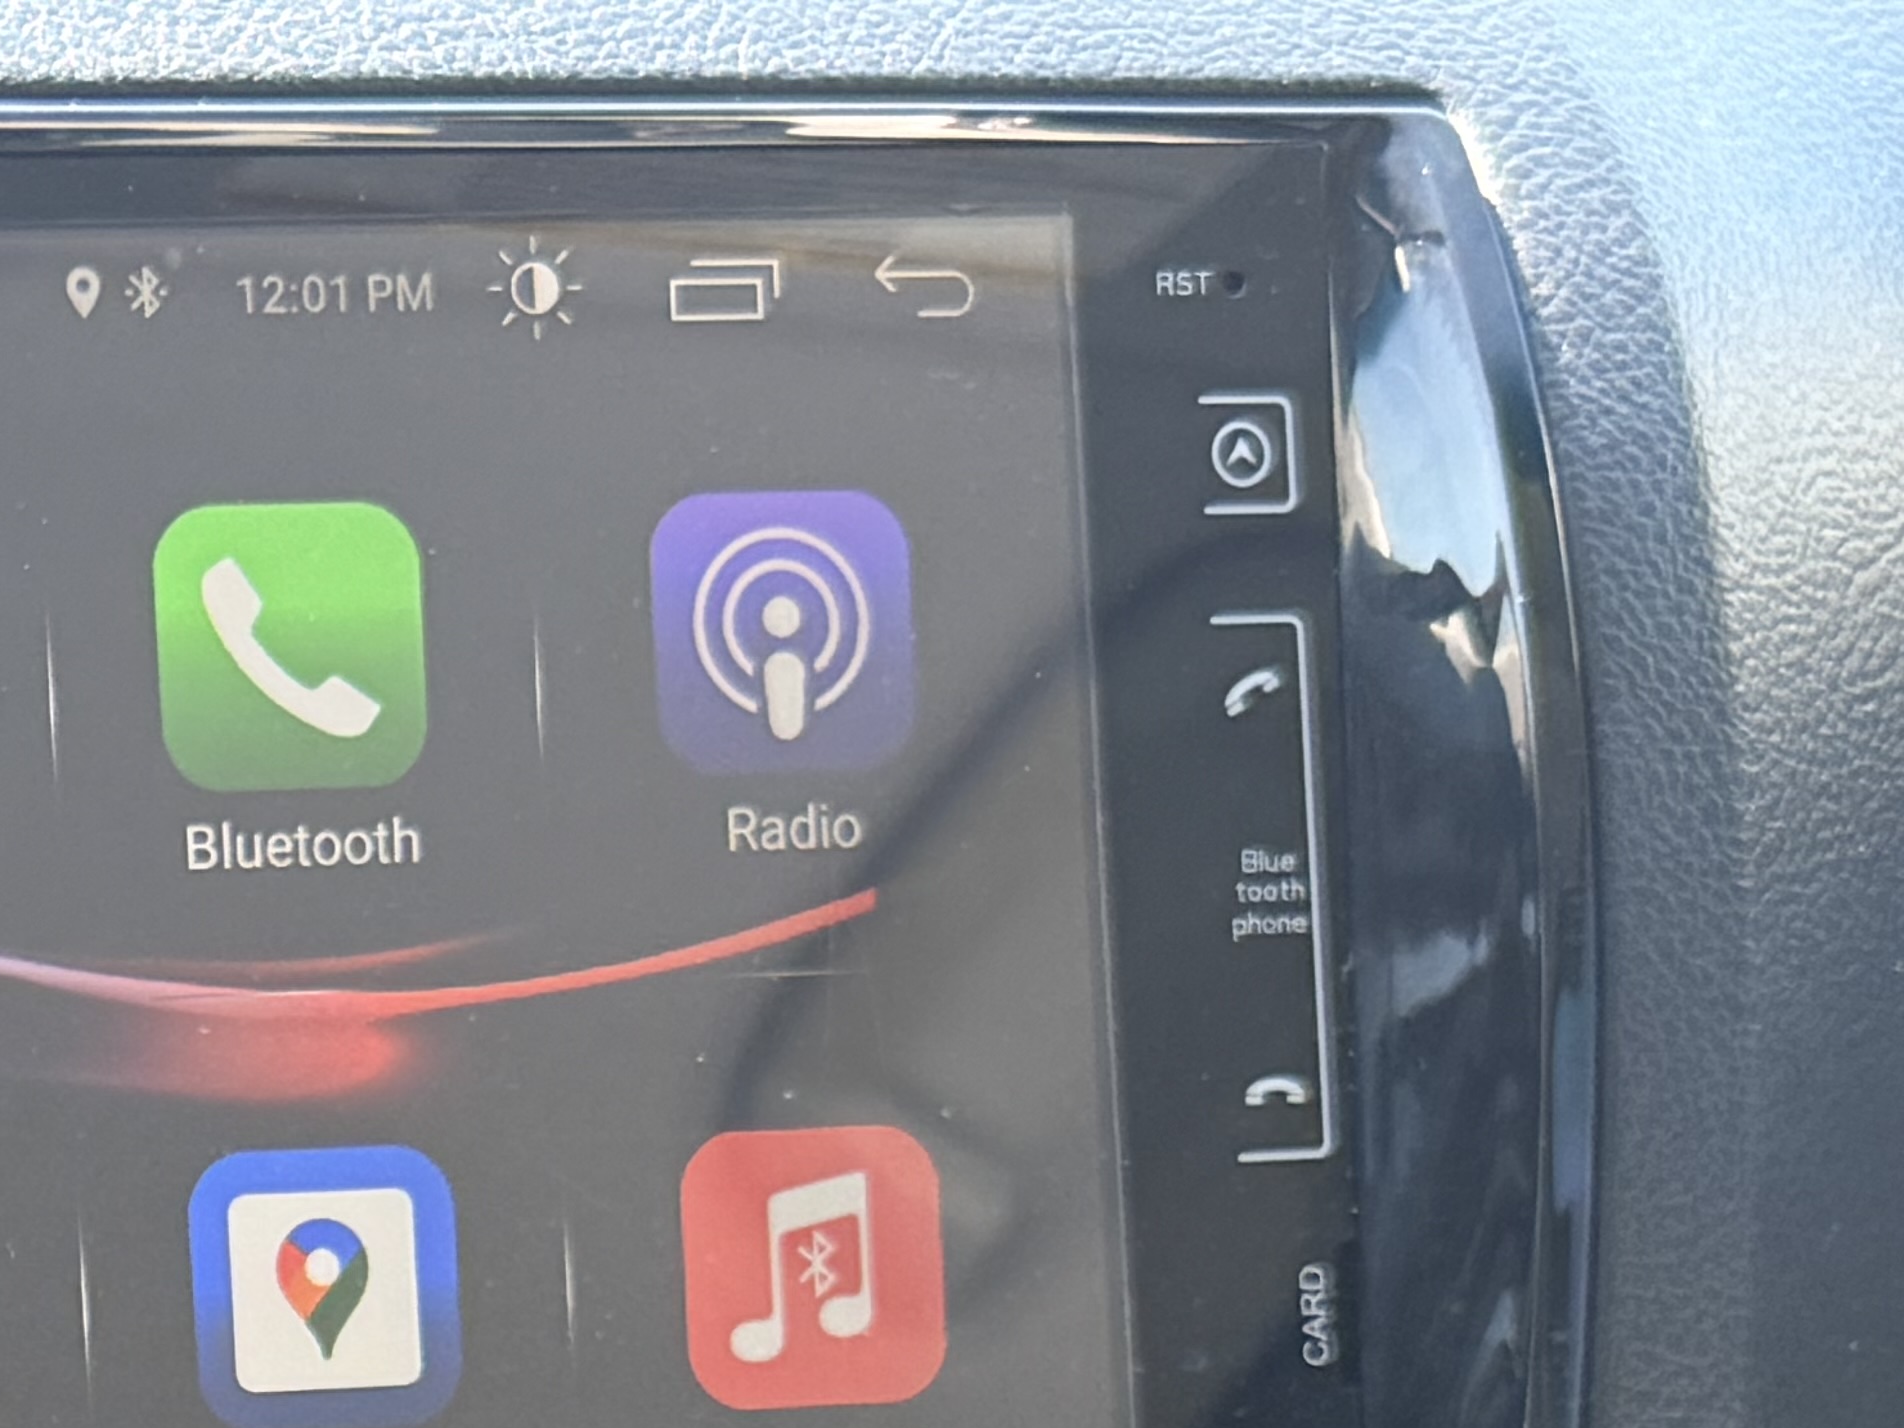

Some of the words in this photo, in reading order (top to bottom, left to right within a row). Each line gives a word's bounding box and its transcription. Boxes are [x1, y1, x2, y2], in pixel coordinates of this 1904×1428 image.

[236, 274, 349, 314] 12:01
[367, 272, 434, 312] PM
[1156, 271, 1213, 297] RST
[186, 817, 420, 870] Bluetooth
[727, 804, 864, 853] Radio
[1241, 849, 1296, 874] Blue
[1235, 878, 1306, 903] tooth
[1232, 912, 1309, 942] phone
[1301, 1265, 1331, 1366] CARD
